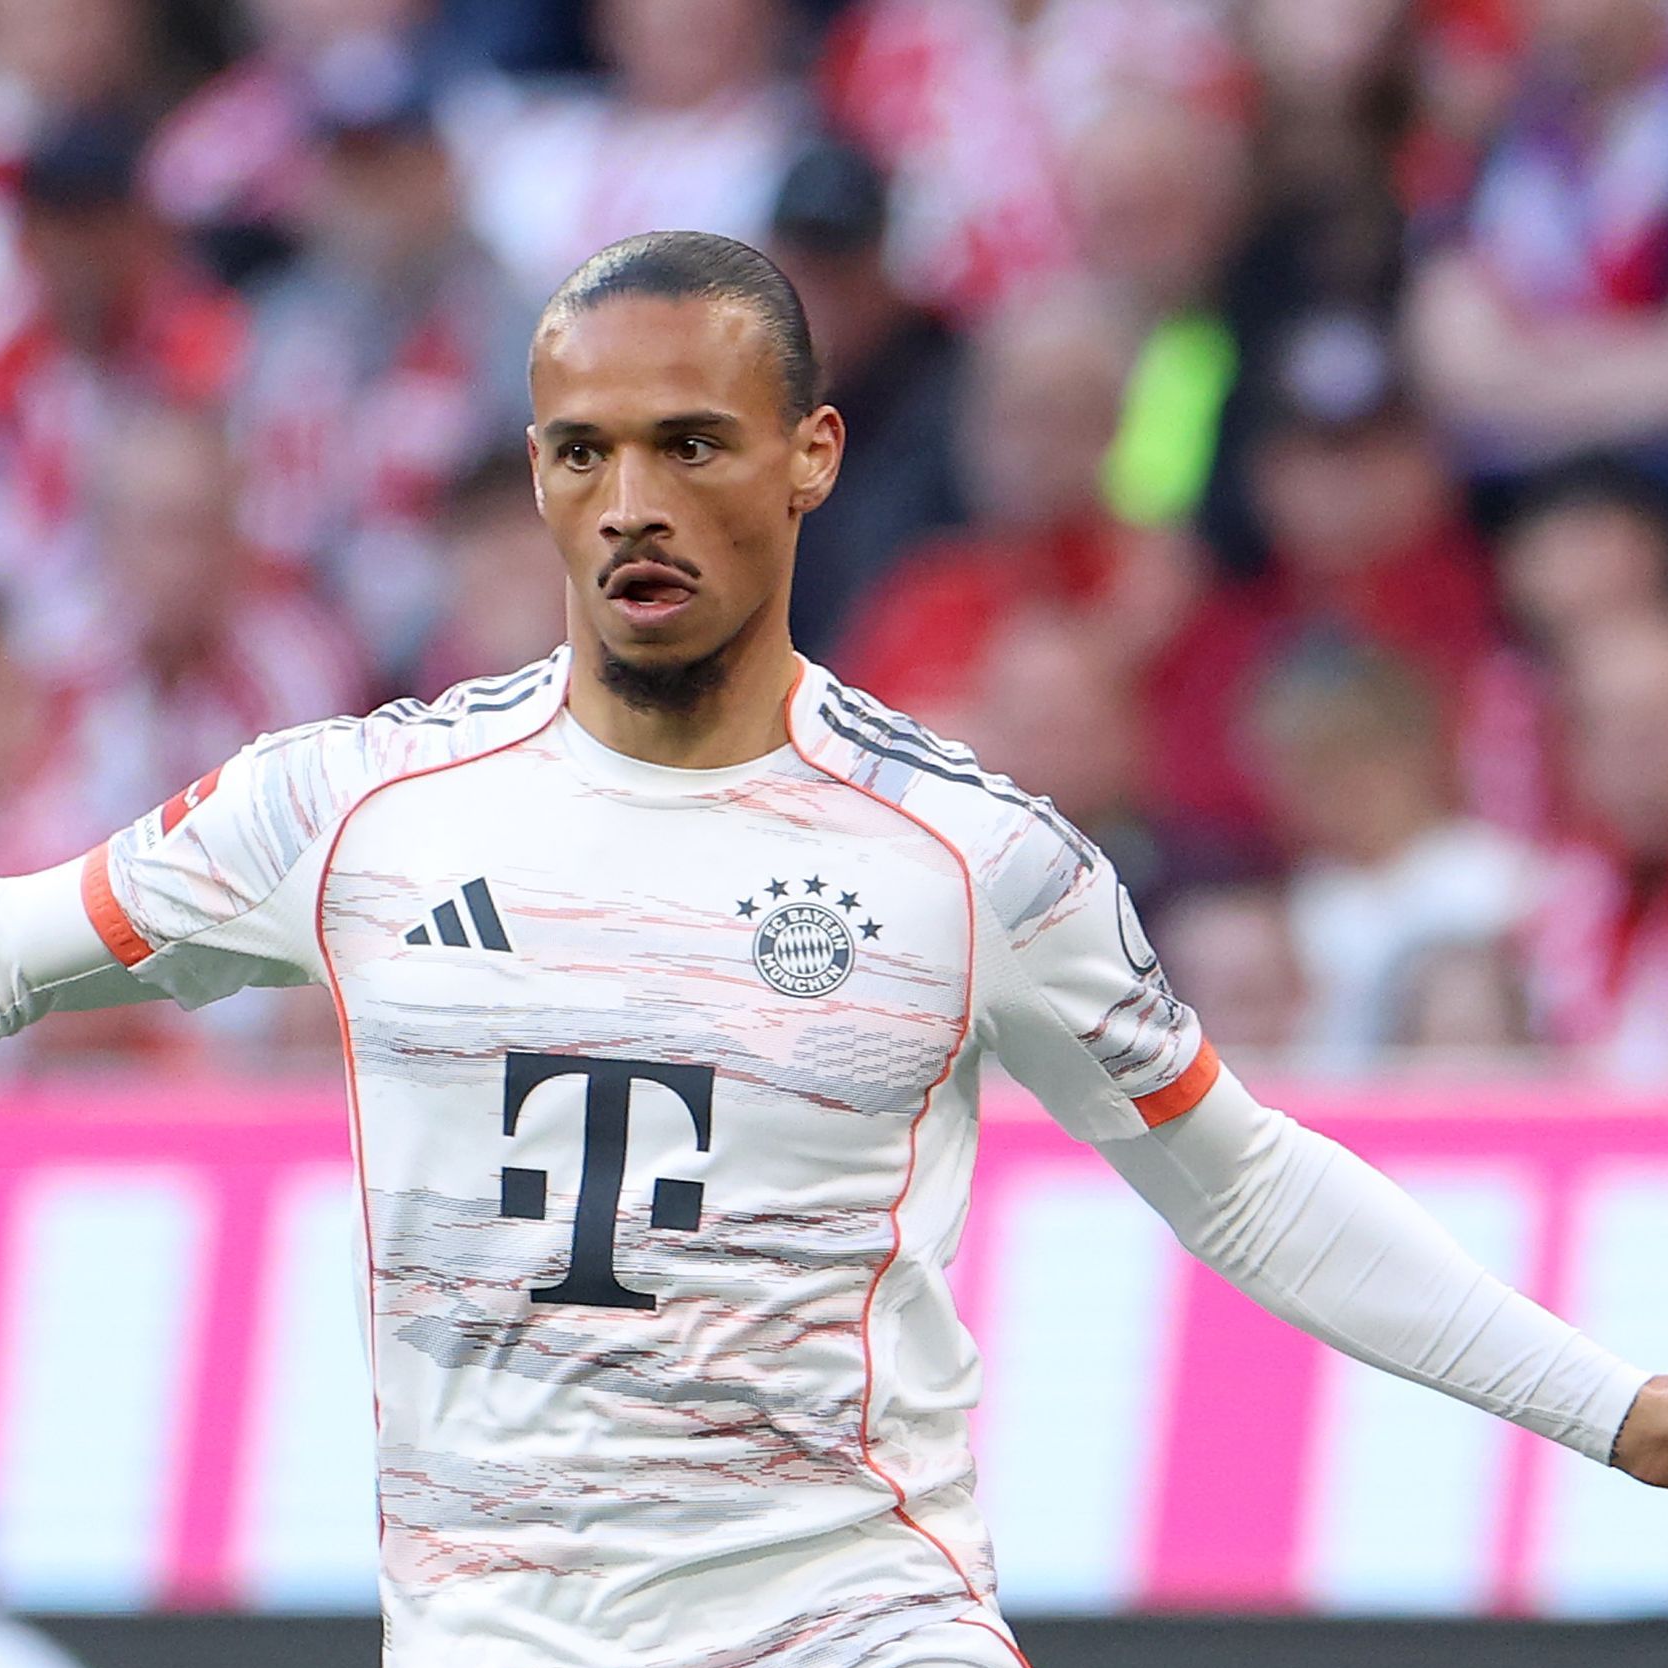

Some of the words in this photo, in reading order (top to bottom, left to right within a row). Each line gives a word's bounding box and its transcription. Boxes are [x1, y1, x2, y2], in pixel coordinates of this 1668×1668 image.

[764, 916, 787, 939] FC
[786, 909, 849, 951] BAYERN
[501, 1051, 715, 1310] T
